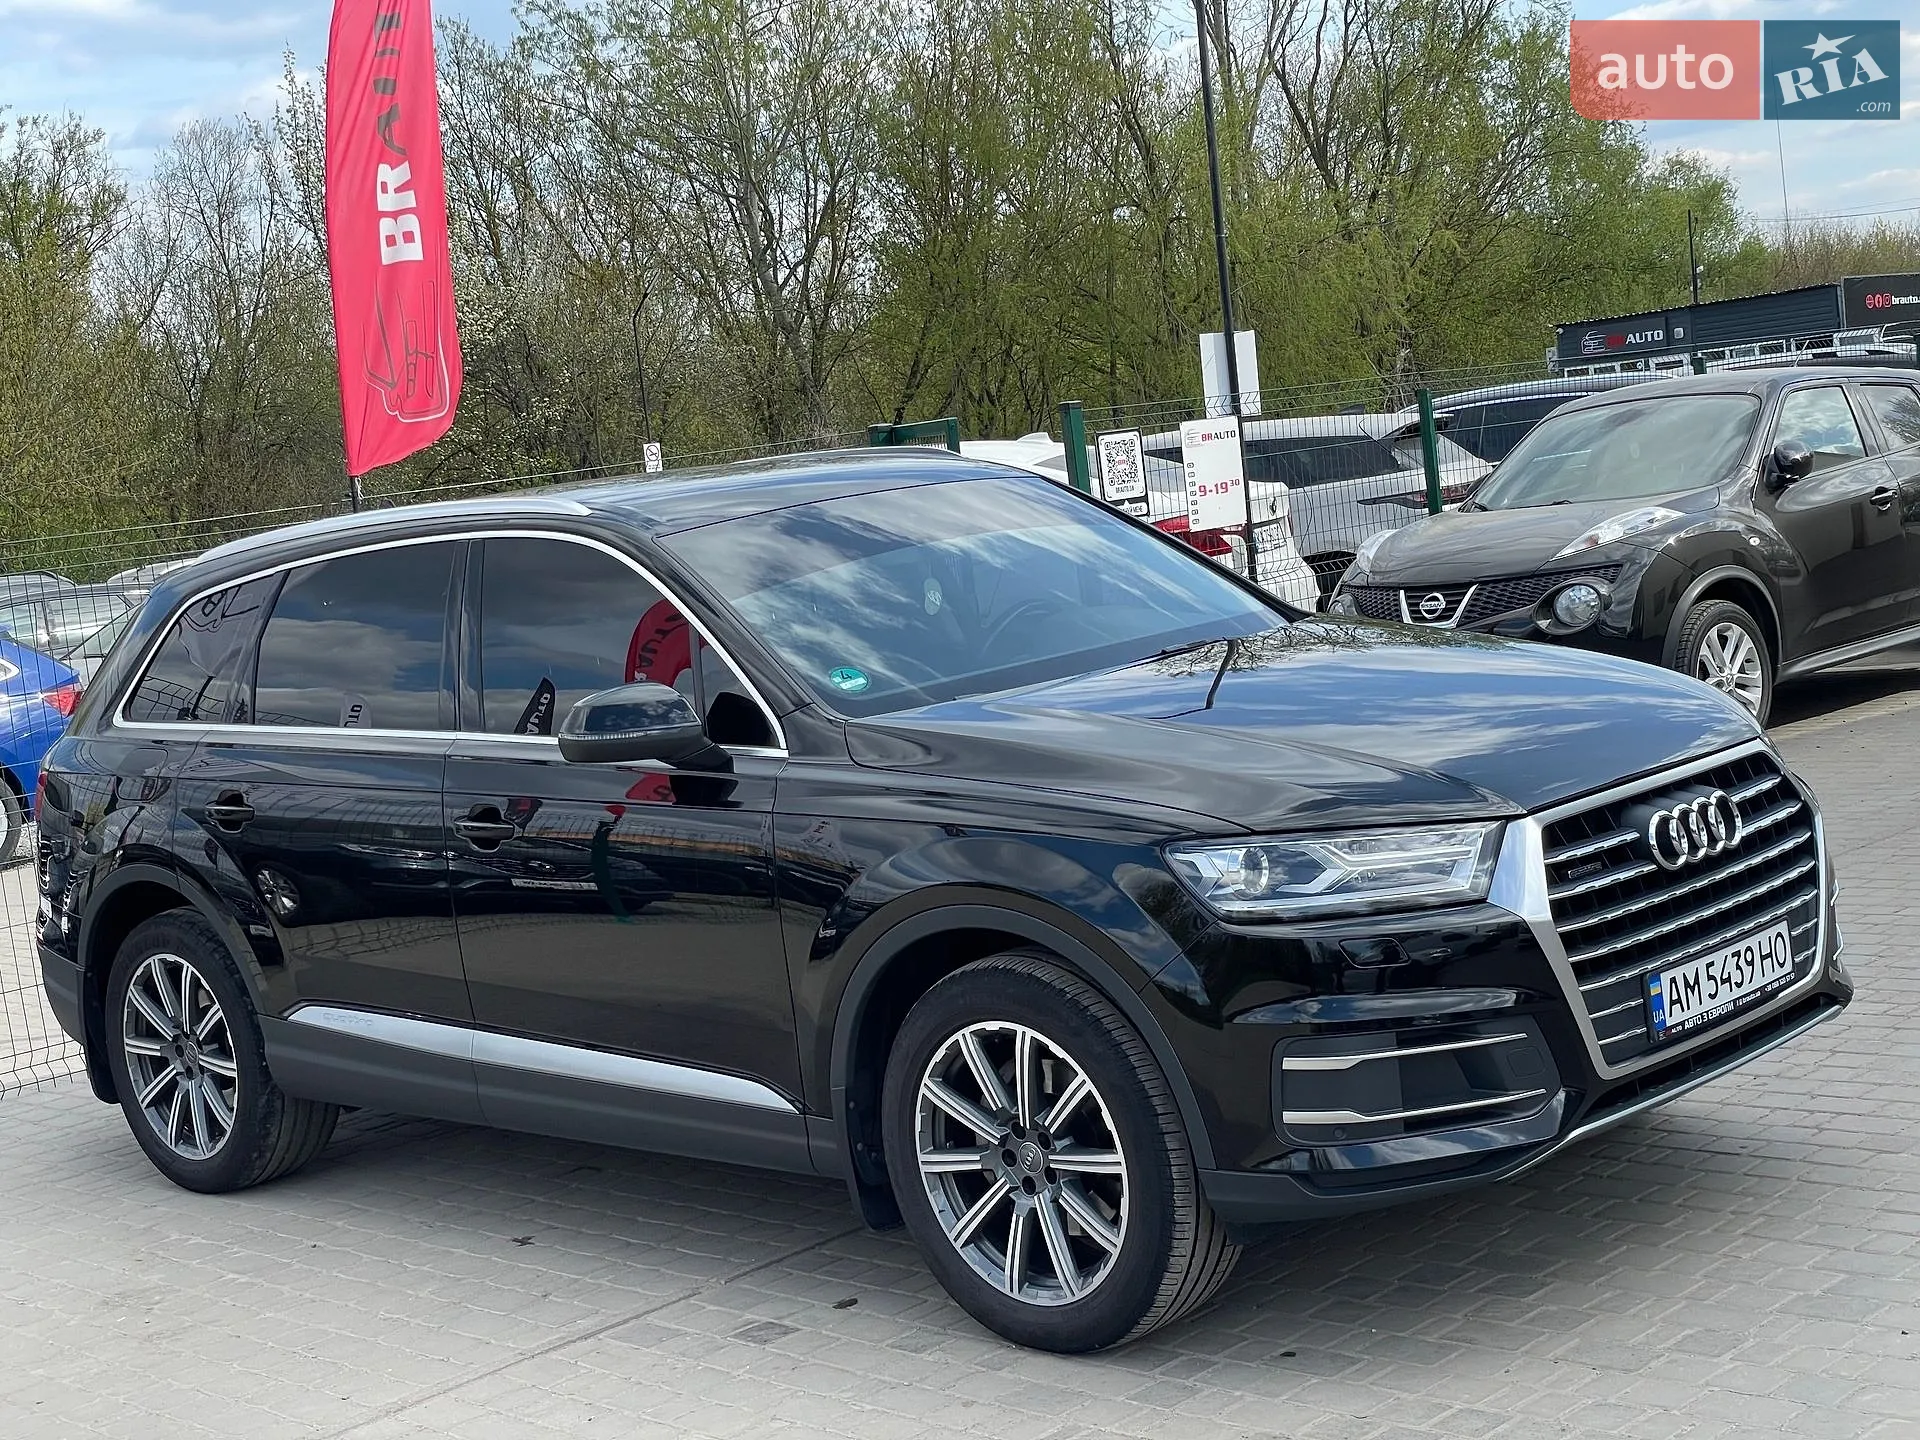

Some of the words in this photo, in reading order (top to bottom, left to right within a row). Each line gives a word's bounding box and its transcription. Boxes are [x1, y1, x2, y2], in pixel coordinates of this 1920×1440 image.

[1201, 429, 1237, 442] BRAUTO
[1669, 966, 1702, 1018] AM
[1705, 945, 1755, 1000] 5439
[1758, 931, 1787, 978] HO
[1653, 1009, 1665, 1024] UA
